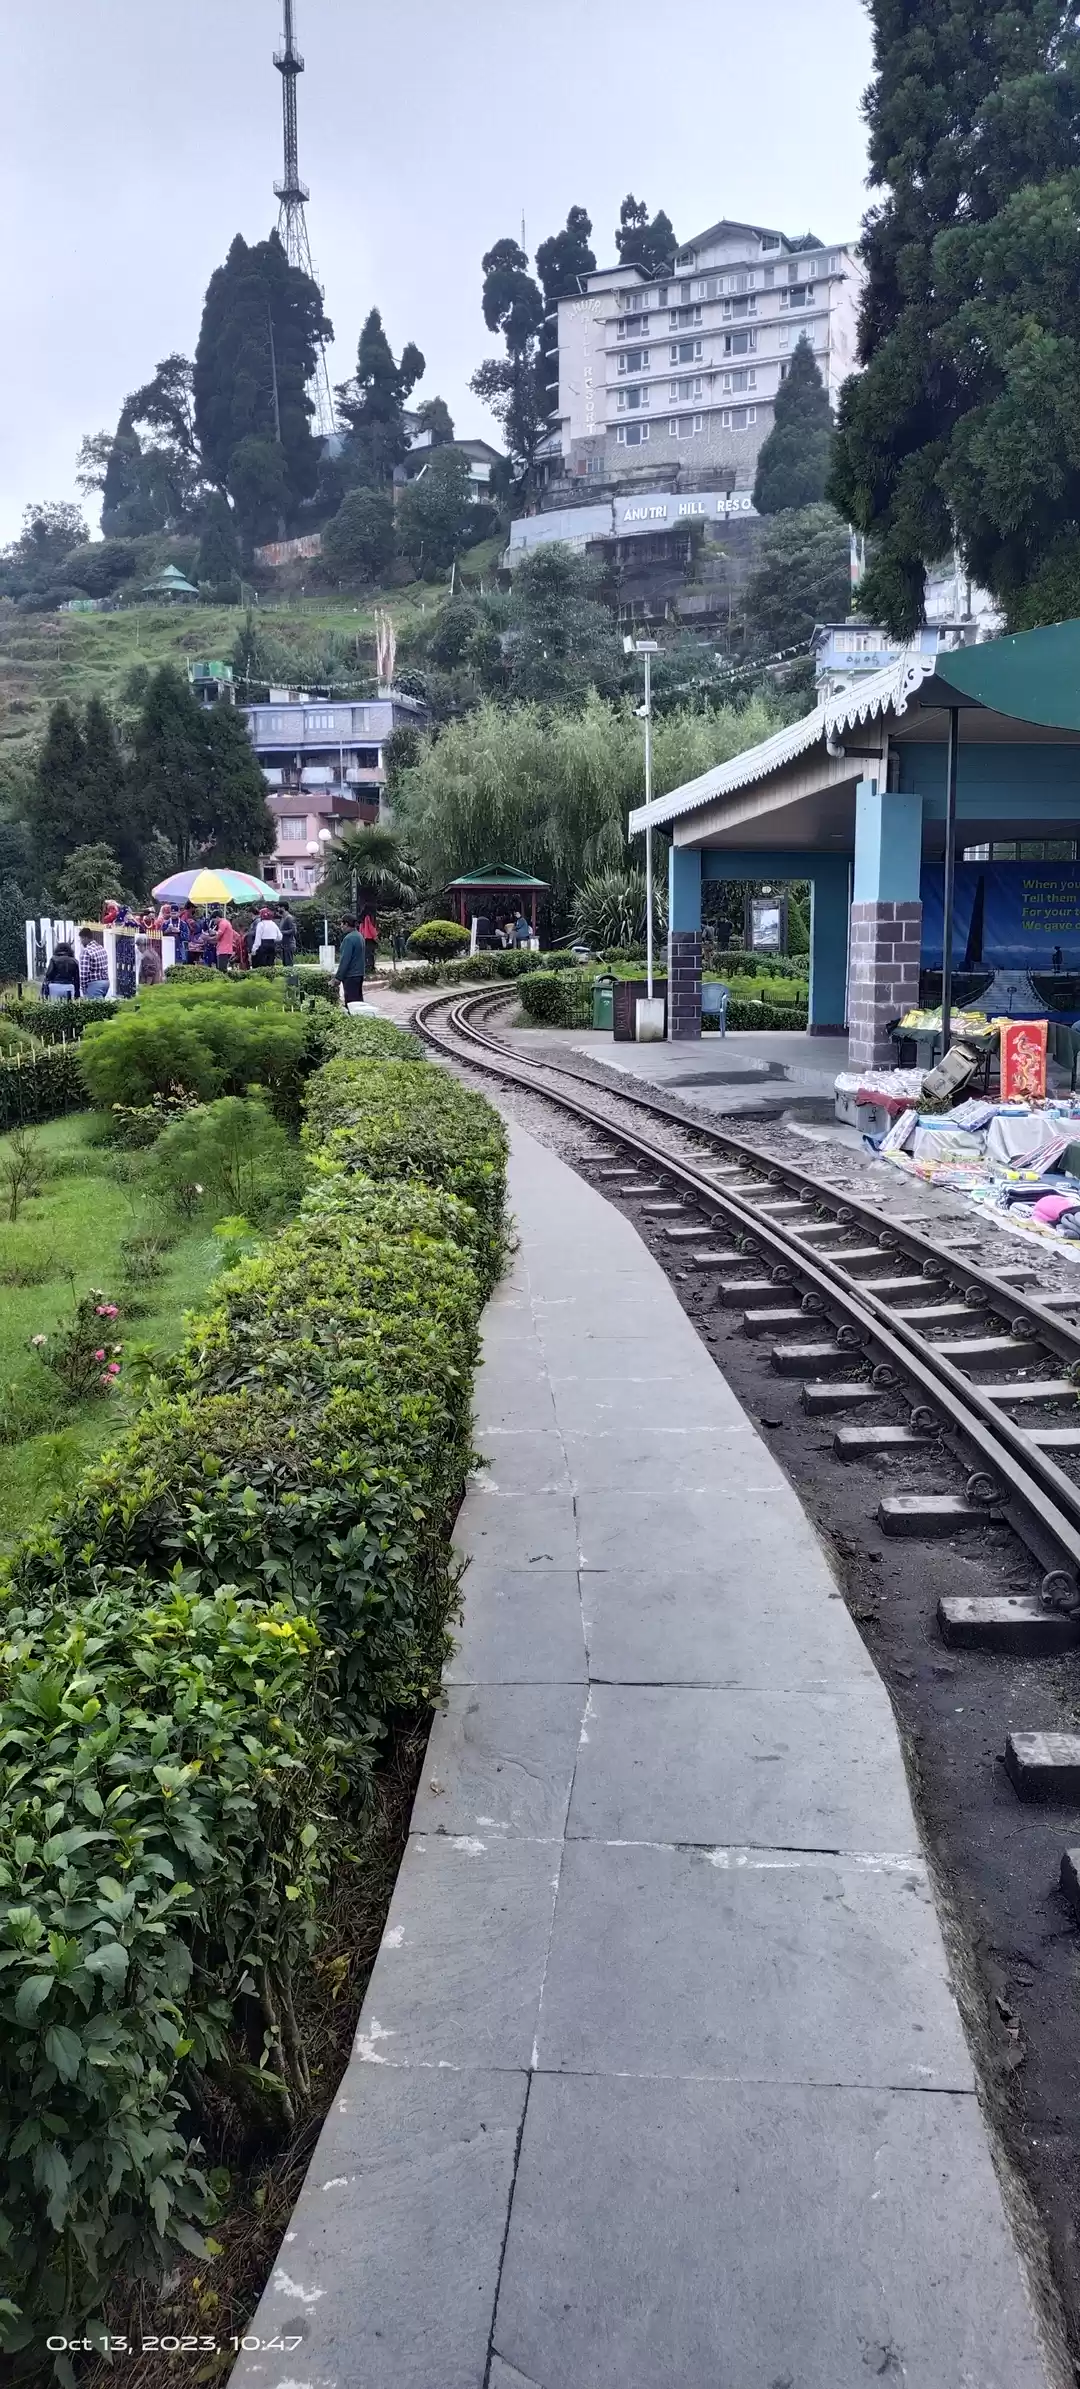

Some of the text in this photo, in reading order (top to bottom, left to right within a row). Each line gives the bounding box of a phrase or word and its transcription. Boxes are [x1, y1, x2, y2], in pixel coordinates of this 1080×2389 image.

[583, 366, 597, 435] RESORT
[623, 498, 755, 522] ANUTRI HILL RESO
[1022, 879, 1057, 889] When
[1021, 893, 1077, 903] Tell them
[1021, 907, 1042, 917] For
[1044, 908, 1072, 919] your
[1022, 920, 1041, 930] We
[1044, 922, 1073, 932] gave
